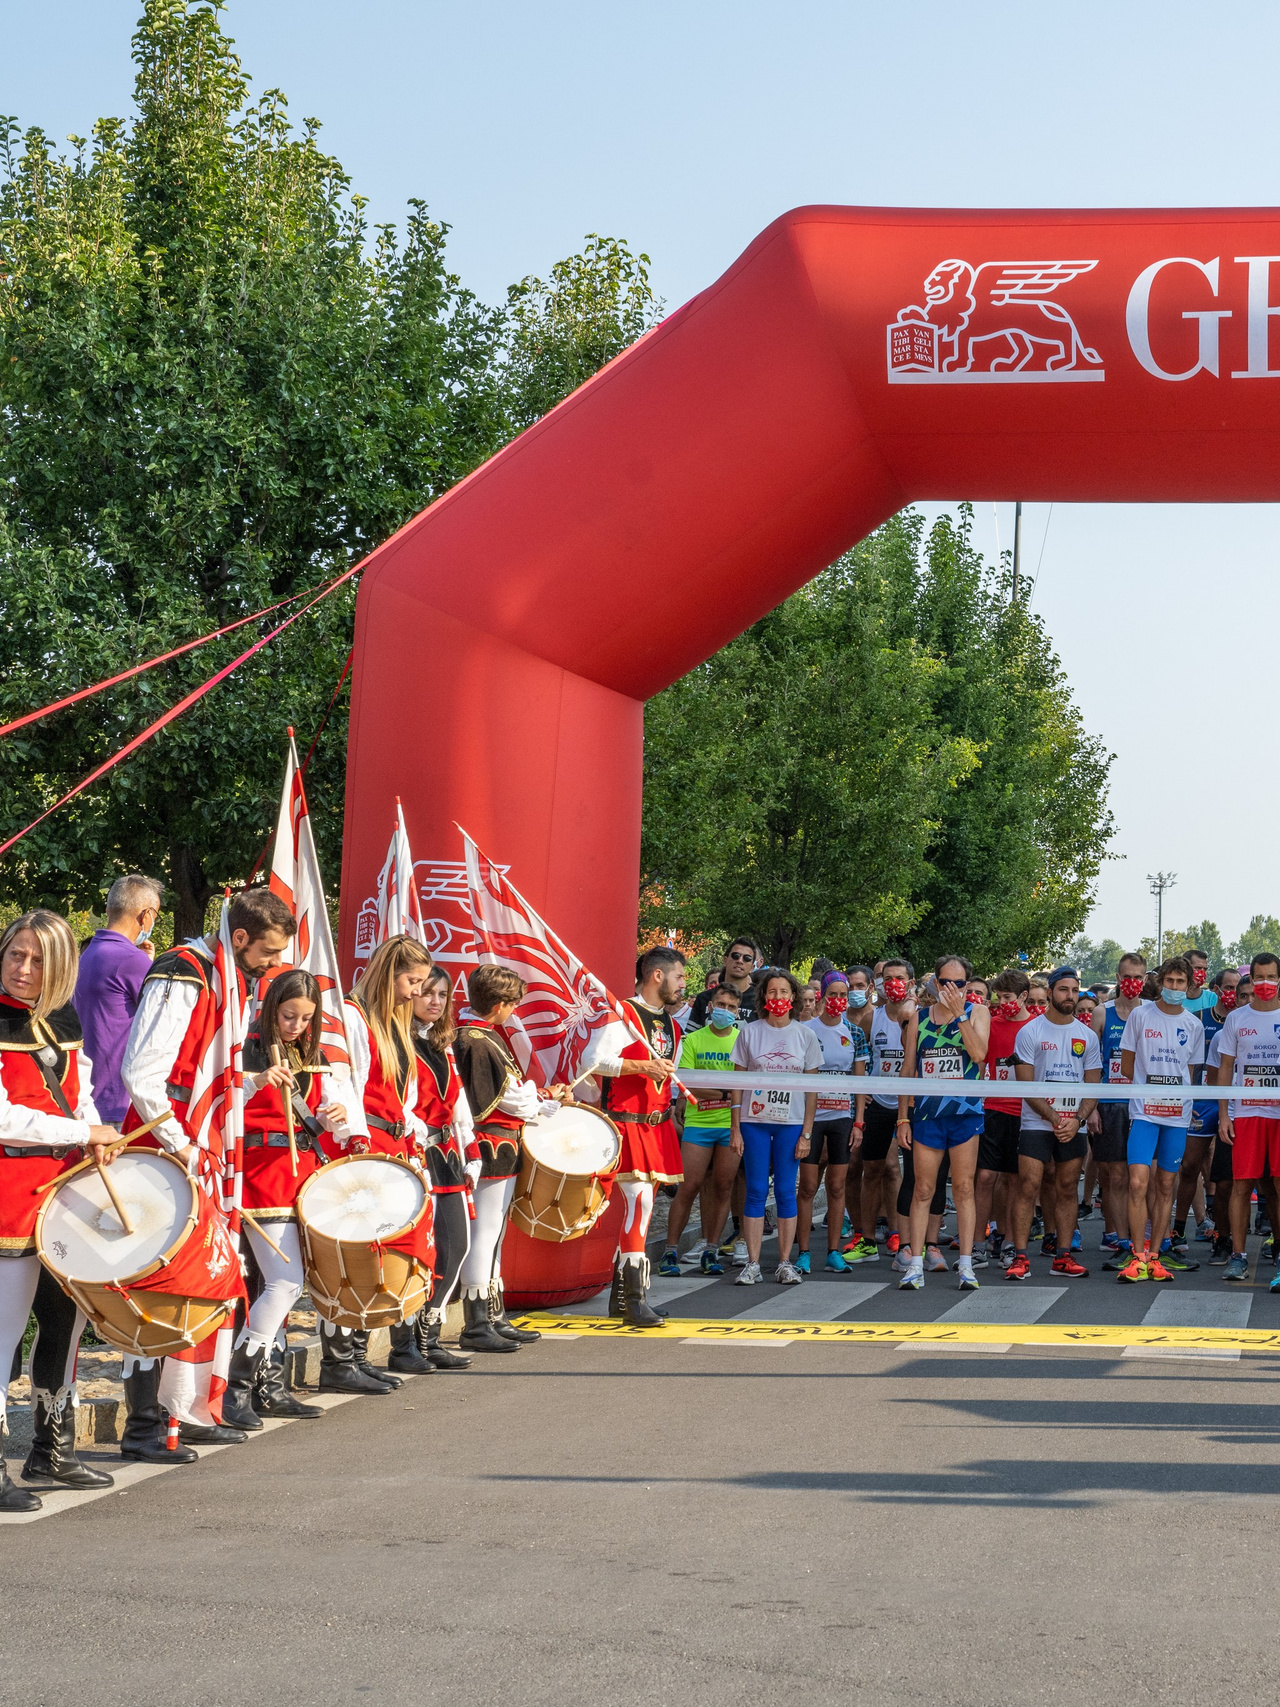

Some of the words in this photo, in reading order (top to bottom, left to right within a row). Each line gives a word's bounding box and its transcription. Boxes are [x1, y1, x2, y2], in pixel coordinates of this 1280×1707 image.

[894, 329, 909, 338] PAX
[913, 329, 930, 338] VAN
[893, 337, 910, 347] TIBI
[913, 337, 931, 347] GELI
[893, 345, 911, 355] MAR
[914, 345, 929, 354] STA
[893, 354, 905, 363] CE
[1145, 1030, 1162, 1038] IDEA
[1239, 1029, 1257, 1037] IDEA
[938, 1047, 959, 1056] IDEA
[1041, 1043, 1058, 1051] IDEA
[1247, 1052, 1260, 1060] San
[882, 1061, 891, 1073] 13
[924, 1061, 935, 1074] 13
[939, 1059, 961, 1072] 224
[1110, 1061, 1120, 1073] 13
[1258, 1066, 1277, 1074] IDEA
[998, 1069, 1009, 1080] 13
[1163, 1076, 1179, 1084] IDEA
[767, 1090, 791, 1105] 1344
[696, 1326, 960, 1340] Triangolo
